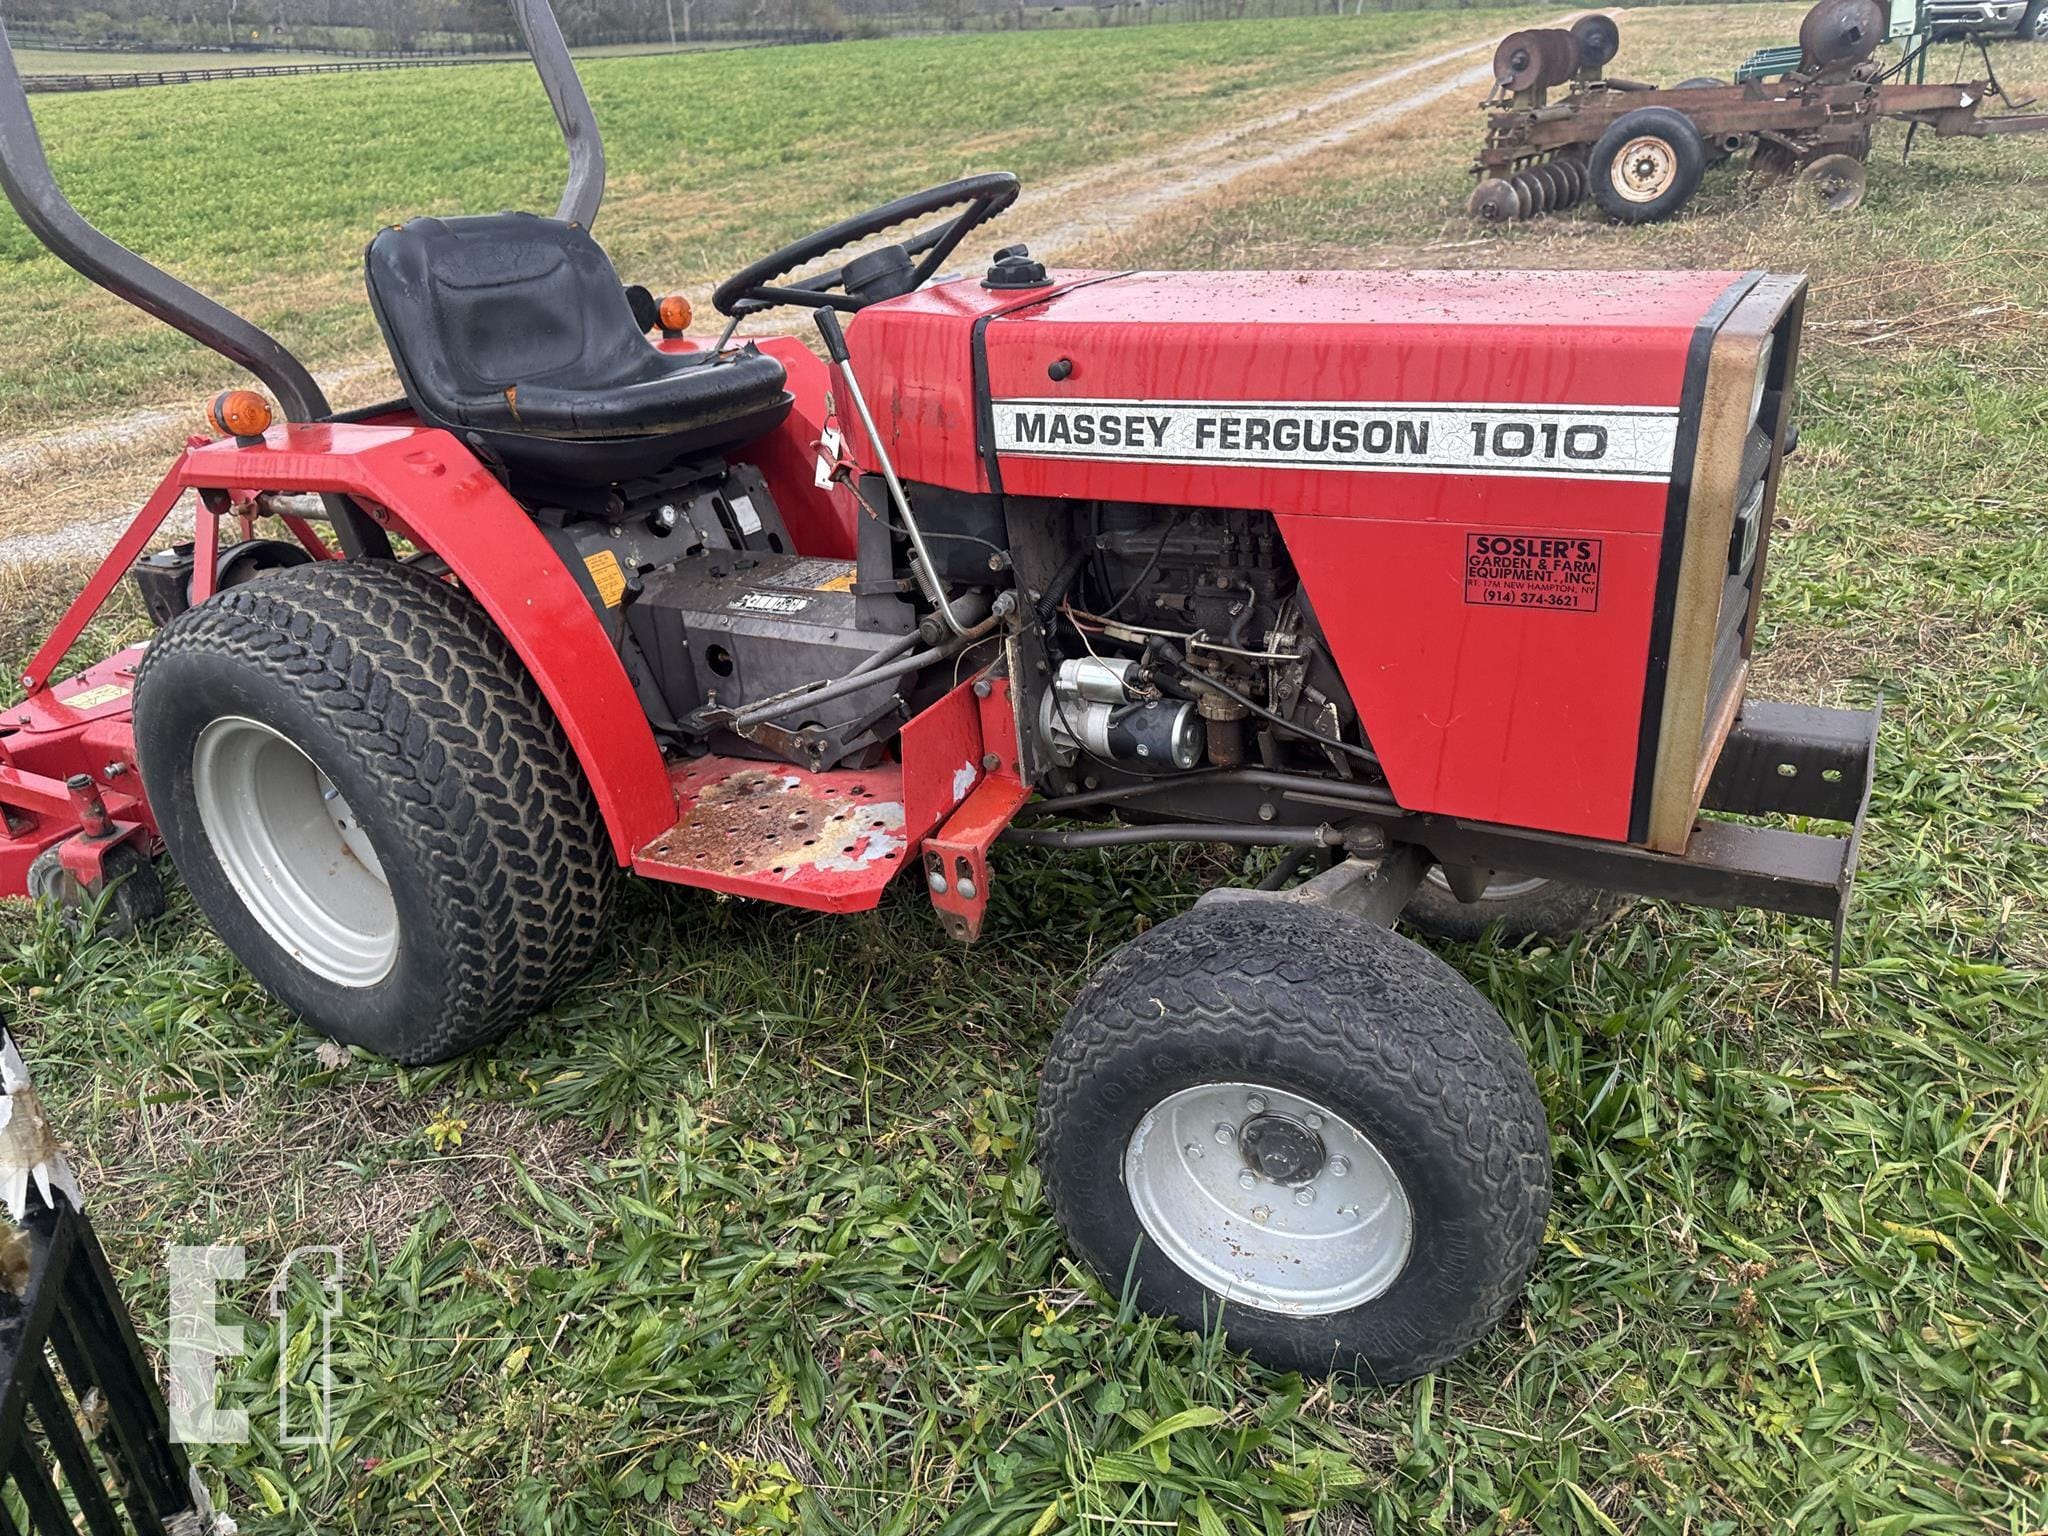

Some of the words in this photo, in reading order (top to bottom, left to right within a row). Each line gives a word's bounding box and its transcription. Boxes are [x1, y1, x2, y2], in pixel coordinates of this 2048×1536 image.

[1014, 412, 1172, 449] MASSEY
[1196, 416, 1430, 455] FERGUSON
[1470, 423, 1609, 460] 1010
[1476, 536, 1591, 560] SOSLER'S
[1469, 555, 1531, 570] GARDEN
[1538, 559, 1547, 570] &
[1554, 560, 1596, 574] FARM
[1483, 588, 1516, 604] (914)
[1520, 592, 1579, 607] 374-3621
[1503, 582, 1525, 590] NEW
[1581, 586, 1596, 595] NY
